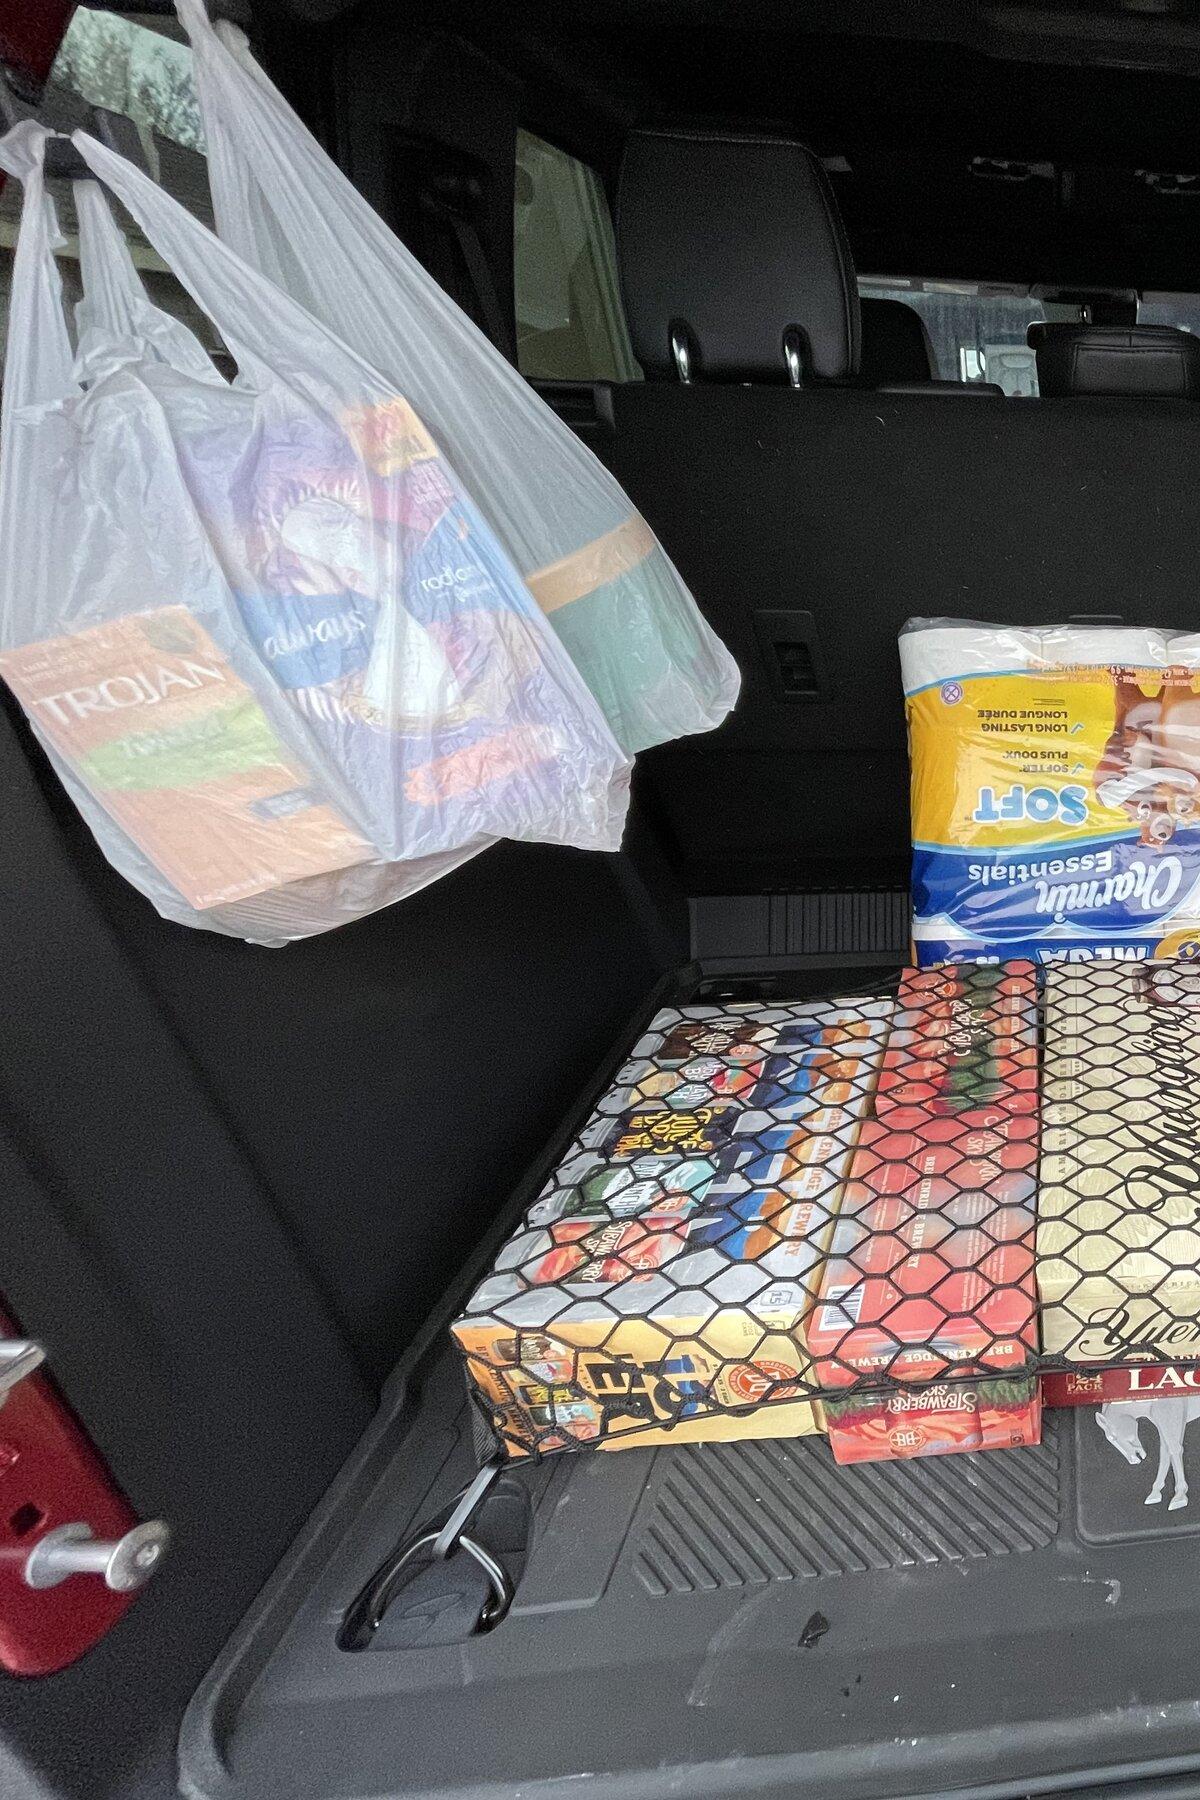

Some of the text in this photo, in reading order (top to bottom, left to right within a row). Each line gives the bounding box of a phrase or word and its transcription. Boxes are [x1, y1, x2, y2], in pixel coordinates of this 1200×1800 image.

[263, 610, 366, 659] always
[33, 660, 226, 726] TROJAN
[978, 709, 1068, 722] LONGUE DURÉE
[981, 722, 1068, 733] LONG LASTING
[1040, 750, 1069, 759] PLUS
[973, 784, 1089, 826] SOFT
[968, 850, 1114, 886] Essentials
[1035, 856, 1183, 924] Charmin
[784, 1196, 816, 1258] REWRY
[907, 1156, 937, 1268] BREENRIDE BREWRY
[580, 1220, 634, 1284] STRAWRRY
[830, 1344, 1014, 1369] BRKENDGE REWEY
[884, 1391, 978, 1414] STRAWBERRY
[1066, 1383, 1104, 1392] PACK
